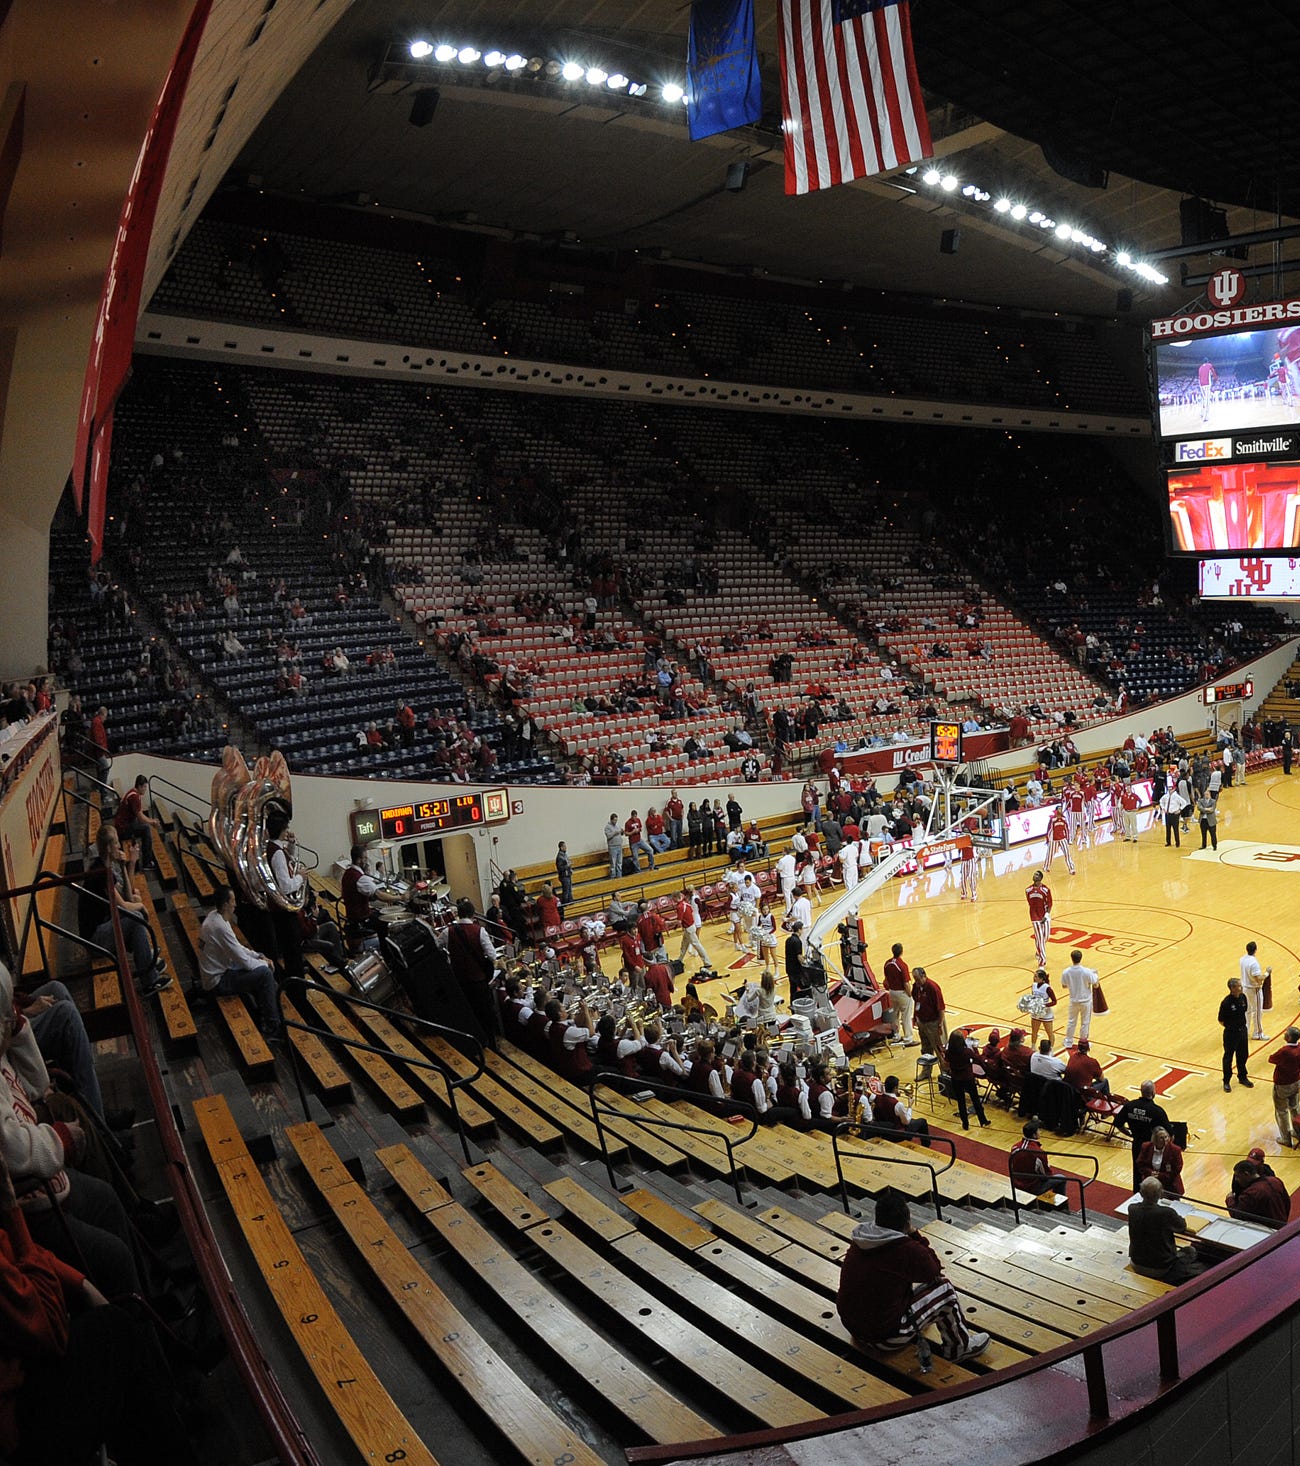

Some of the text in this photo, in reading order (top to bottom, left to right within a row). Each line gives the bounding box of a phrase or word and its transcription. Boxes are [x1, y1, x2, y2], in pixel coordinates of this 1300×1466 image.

[1180, 442, 1224, 460] FedEx
[1236, 438, 1290, 455] Smithville
[937, 726, 958, 739] 15:20
[894, 751, 903, 764] IU
[382, 796, 473, 819] INDIANA 15:21 LIU
[472, 807, 479, 820] 0
[515, 802, 522, 813] 3
[357, 822, 373, 835] Taft
[395, 820, 404, 834] 0
[448, 1219, 462, 1228] 3
[512, 1205, 524, 1213] 2
[549, 1236, 562, 1244] 3
[598, 1217, 610, 1225] 2
[852, 1383, 866, 1392] 7
[233, 1172, 247, 1180] 3
[273, 1260, 289, 1269] 5
[301, 1314, 319, 1324] 6
[337, 1378, 357, 1388] 7
[385, 1449, 406, 1463] 8
[1022, 1330, 1034, 1339] 6
[402, 1282, 417, 1291] 5
[443, 1332, 460, 1343] 6
[554, 1453, 574, 1466] 8
[939, 1374, 954, 1383] 7
